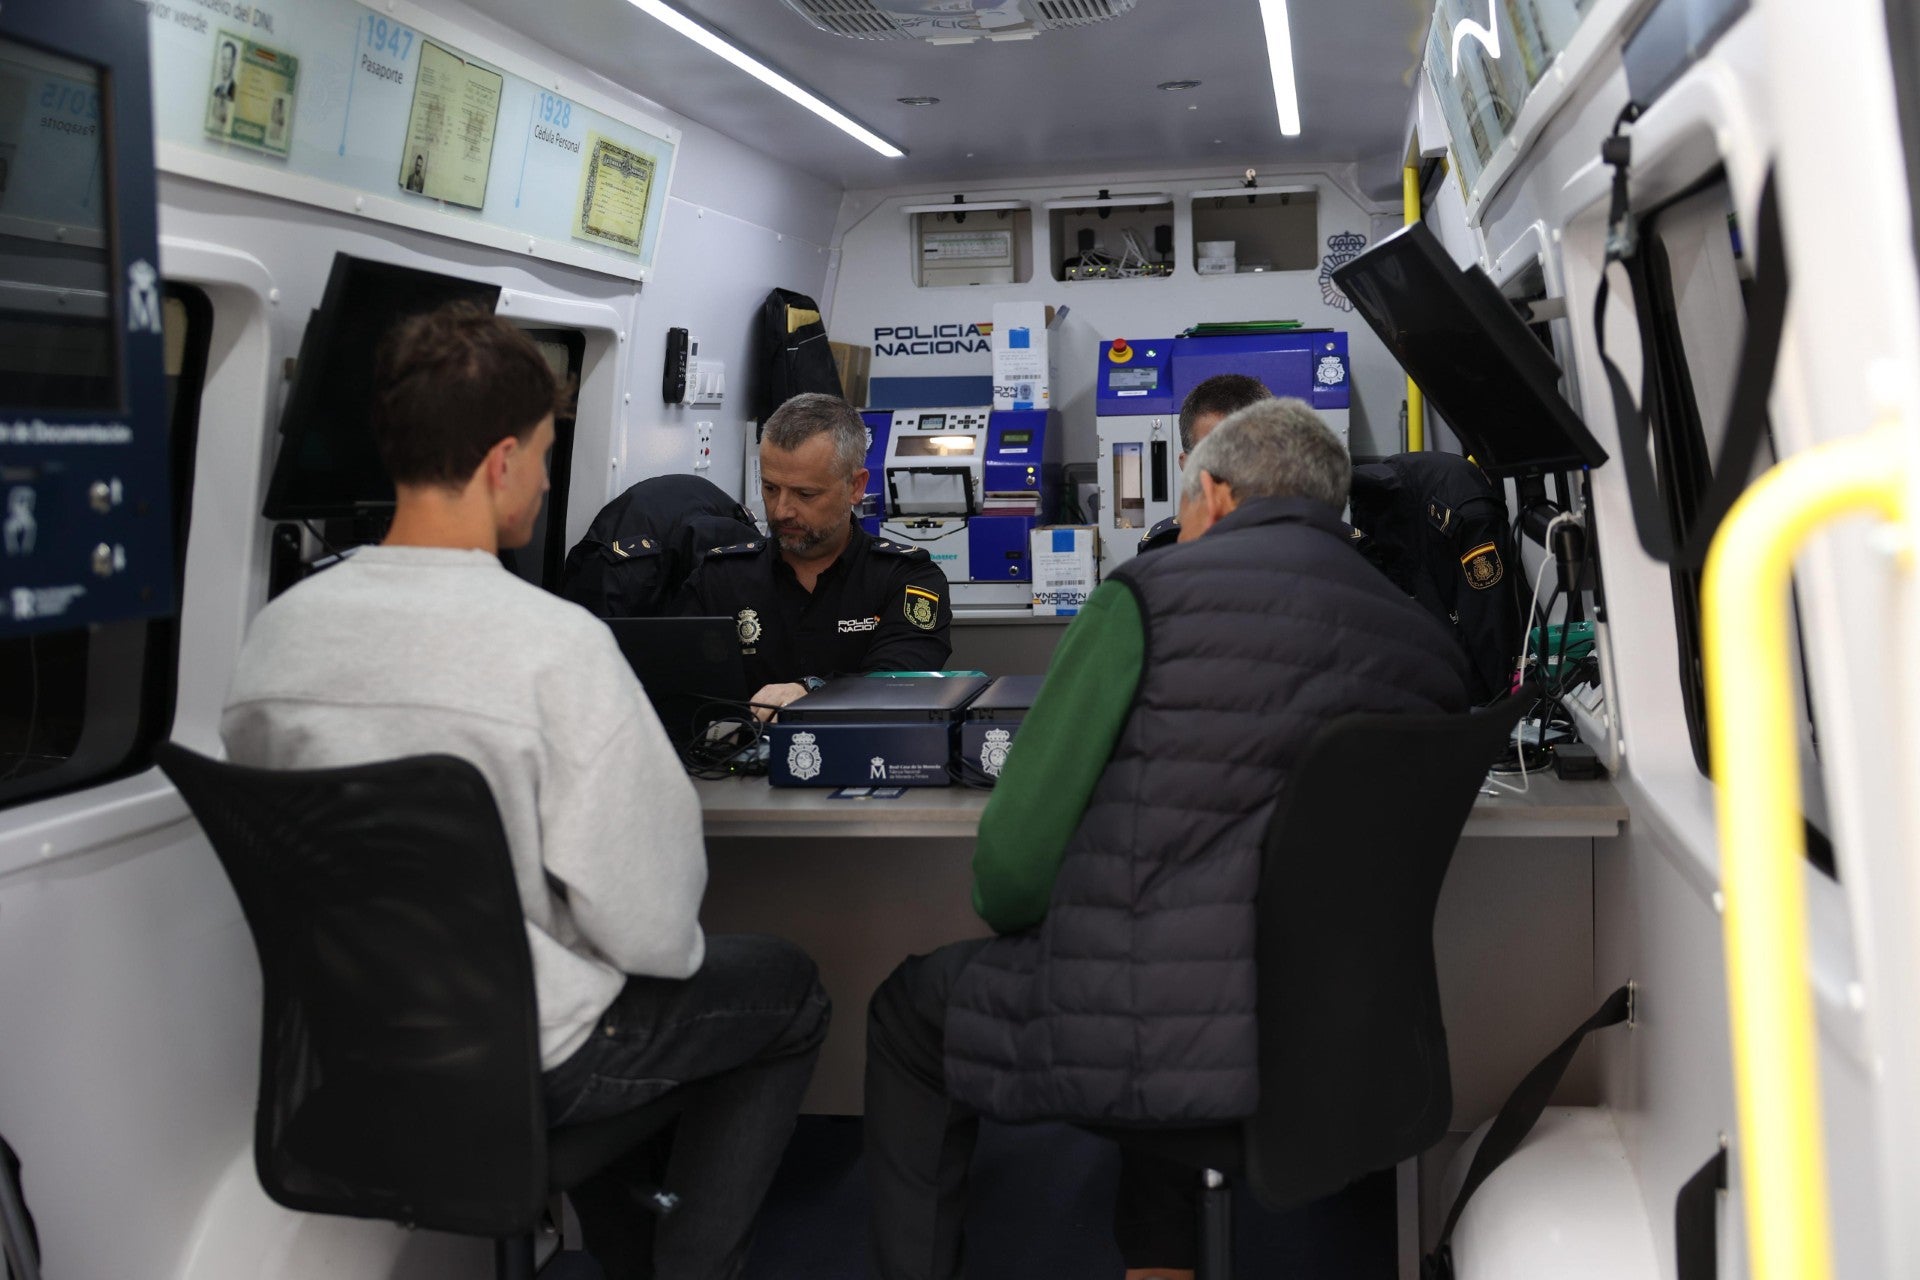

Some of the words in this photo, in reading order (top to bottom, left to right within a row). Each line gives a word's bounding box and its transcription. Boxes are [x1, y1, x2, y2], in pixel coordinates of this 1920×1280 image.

[367, 15, 414, 61] 1947
[361, 54, 403, 84] Pasaporte
[540, 92, 571, 129] 1928
[534, 124, 555, 145] Cédula
[555, 133, 580, 154] Personal
[875, 340, 992, 356] NACIONA
[930, 552, 958, 560] bauer
[838, 617, 875, 627] POLIC
